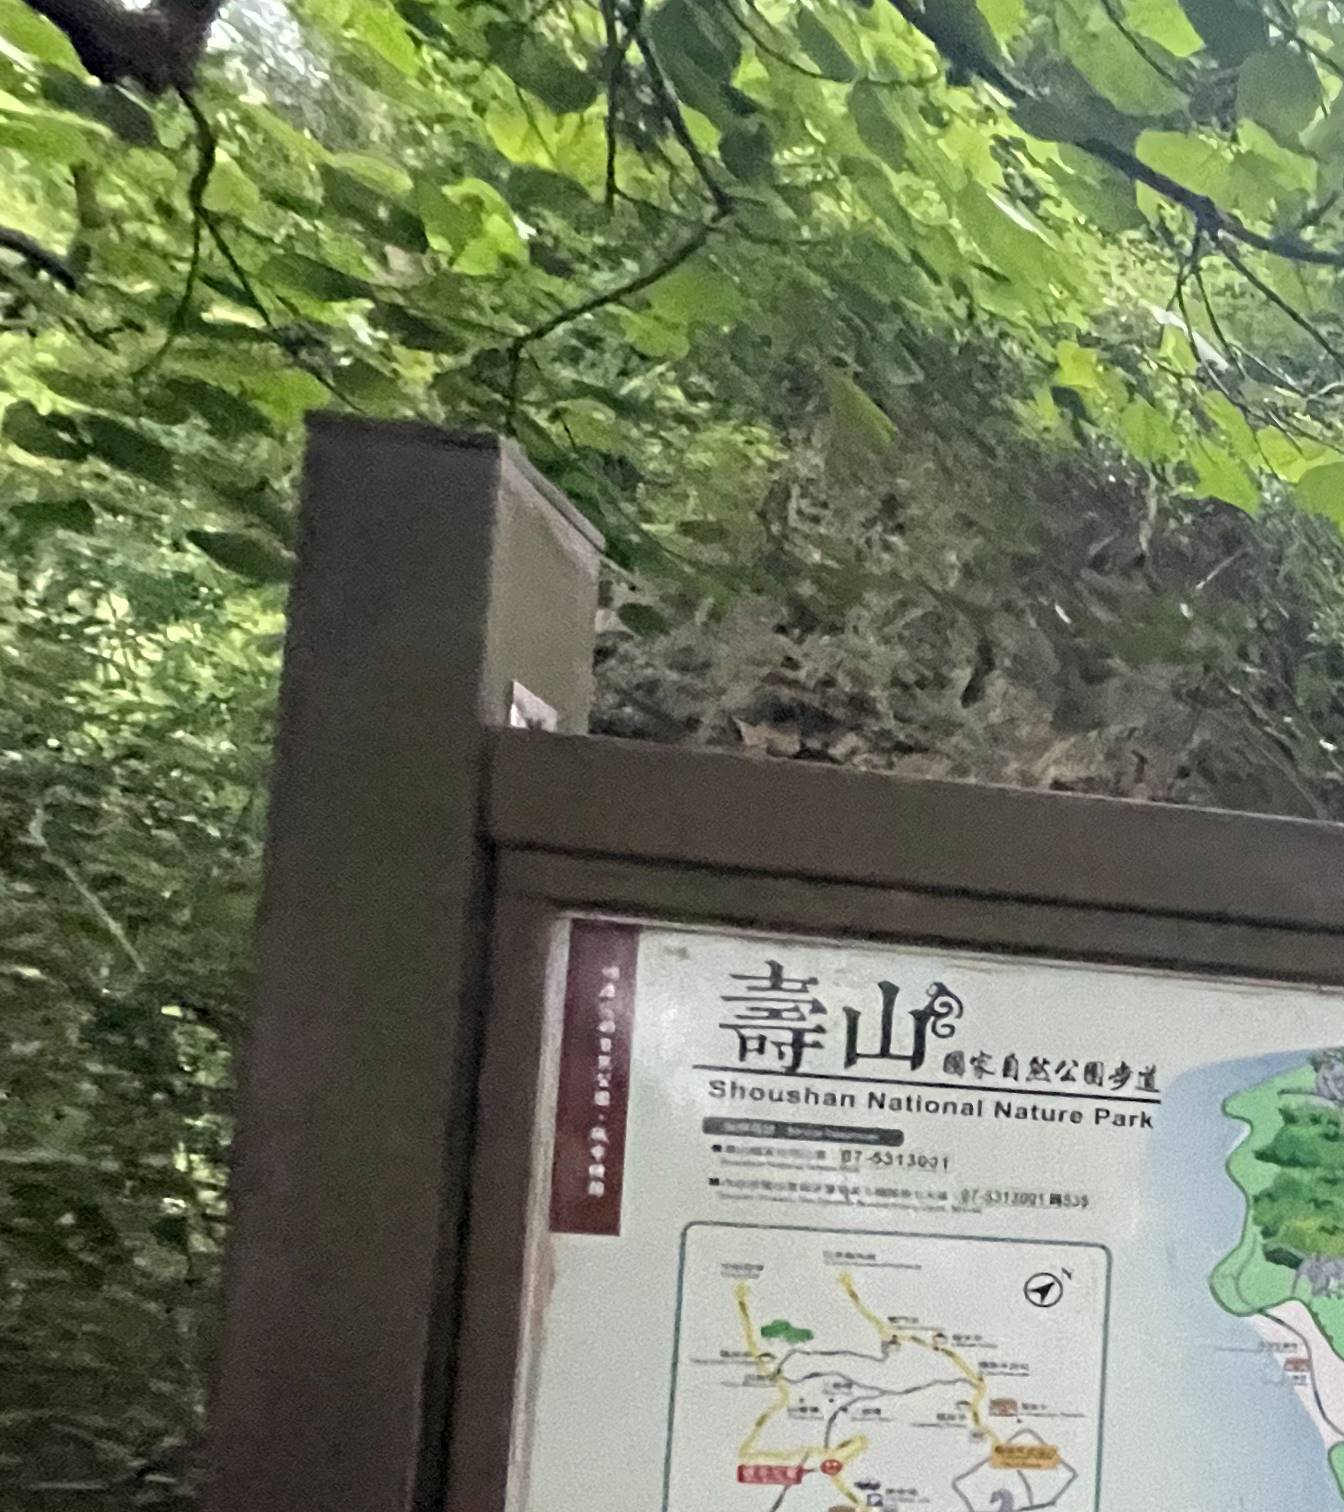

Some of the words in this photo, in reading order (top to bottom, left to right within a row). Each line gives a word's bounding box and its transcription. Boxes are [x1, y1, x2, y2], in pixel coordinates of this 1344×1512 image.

[718, 960, 961, 1074] 壽山
[708, 1079, 856, 1109] Shoushan
[868, 1091, 983, 1117] National
[994, 1100, 1083, 1124] Nature
[1094, 1107, 1154, 1129] Park
